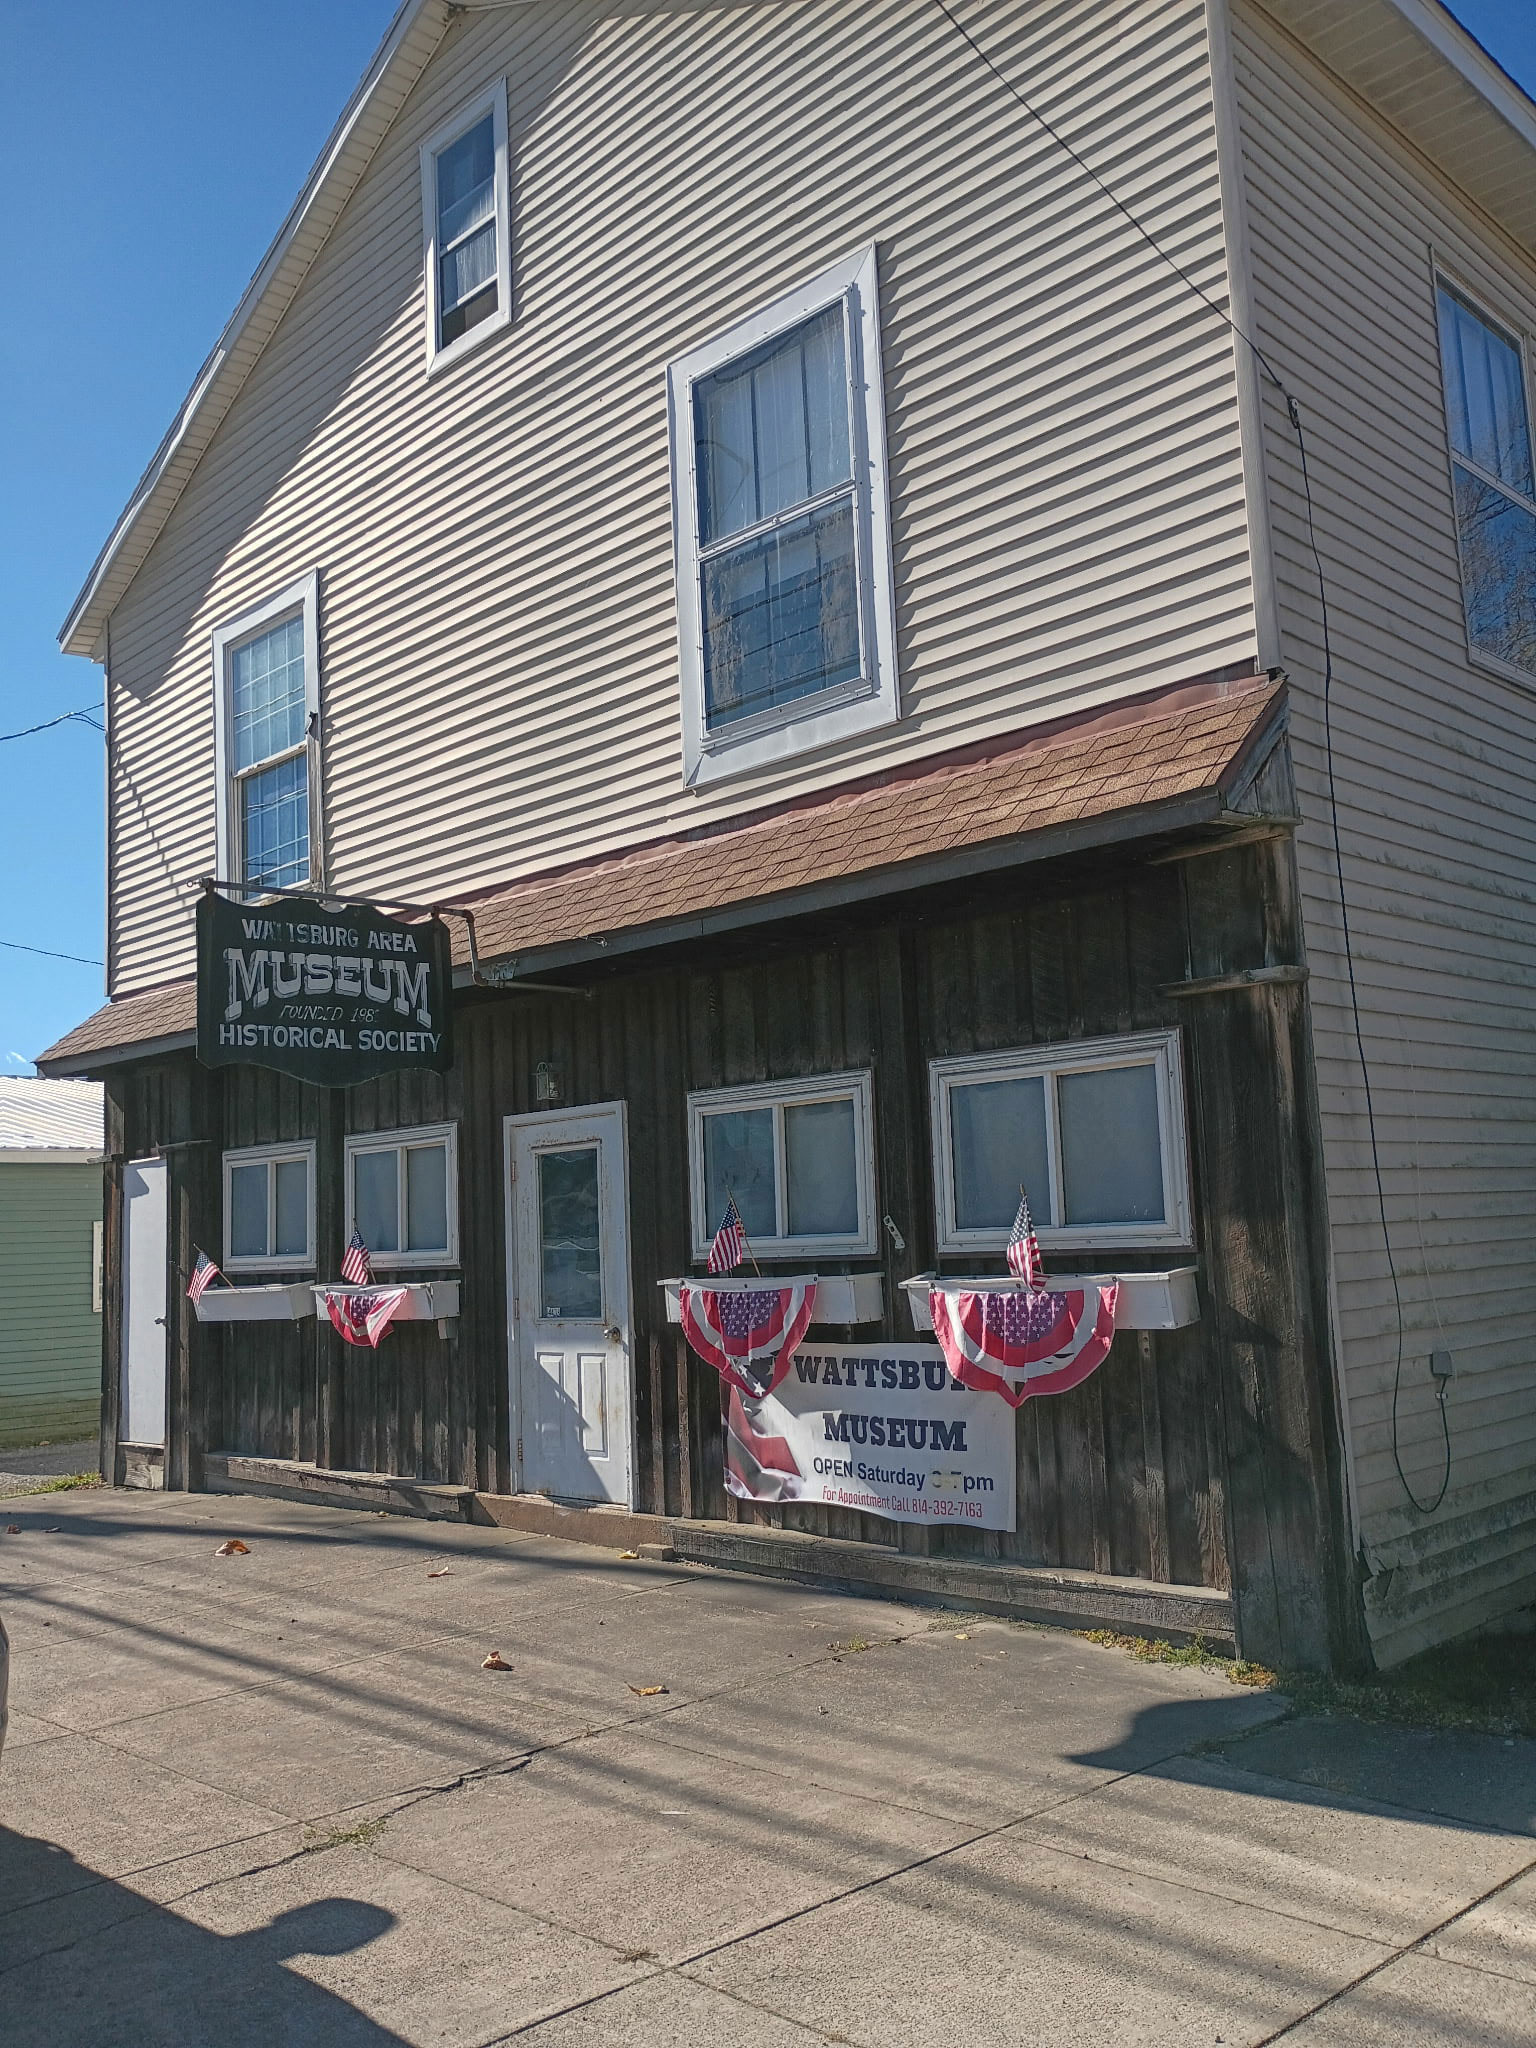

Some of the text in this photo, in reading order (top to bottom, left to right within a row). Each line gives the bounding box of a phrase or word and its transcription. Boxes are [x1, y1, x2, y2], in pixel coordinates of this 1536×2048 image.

[241, 918, 418, 953] WATSBURG AREA
[223, 947, 432, 1029] MUSEUM
[350, 1008, 380, 1023] 198
[219, 1023, 442, 1053] HISTORICAL SOCIETY
[794, 1355, 979, 1391] WATTSBU
[822, 1412, 968, 1452] MUSEUM
[813, 1456, 854, 1478] OPEN
[857, 1462, 926, 1492] Saturday
[822, 1485, 983, 1518] For Appointment Call 814-392-7163
